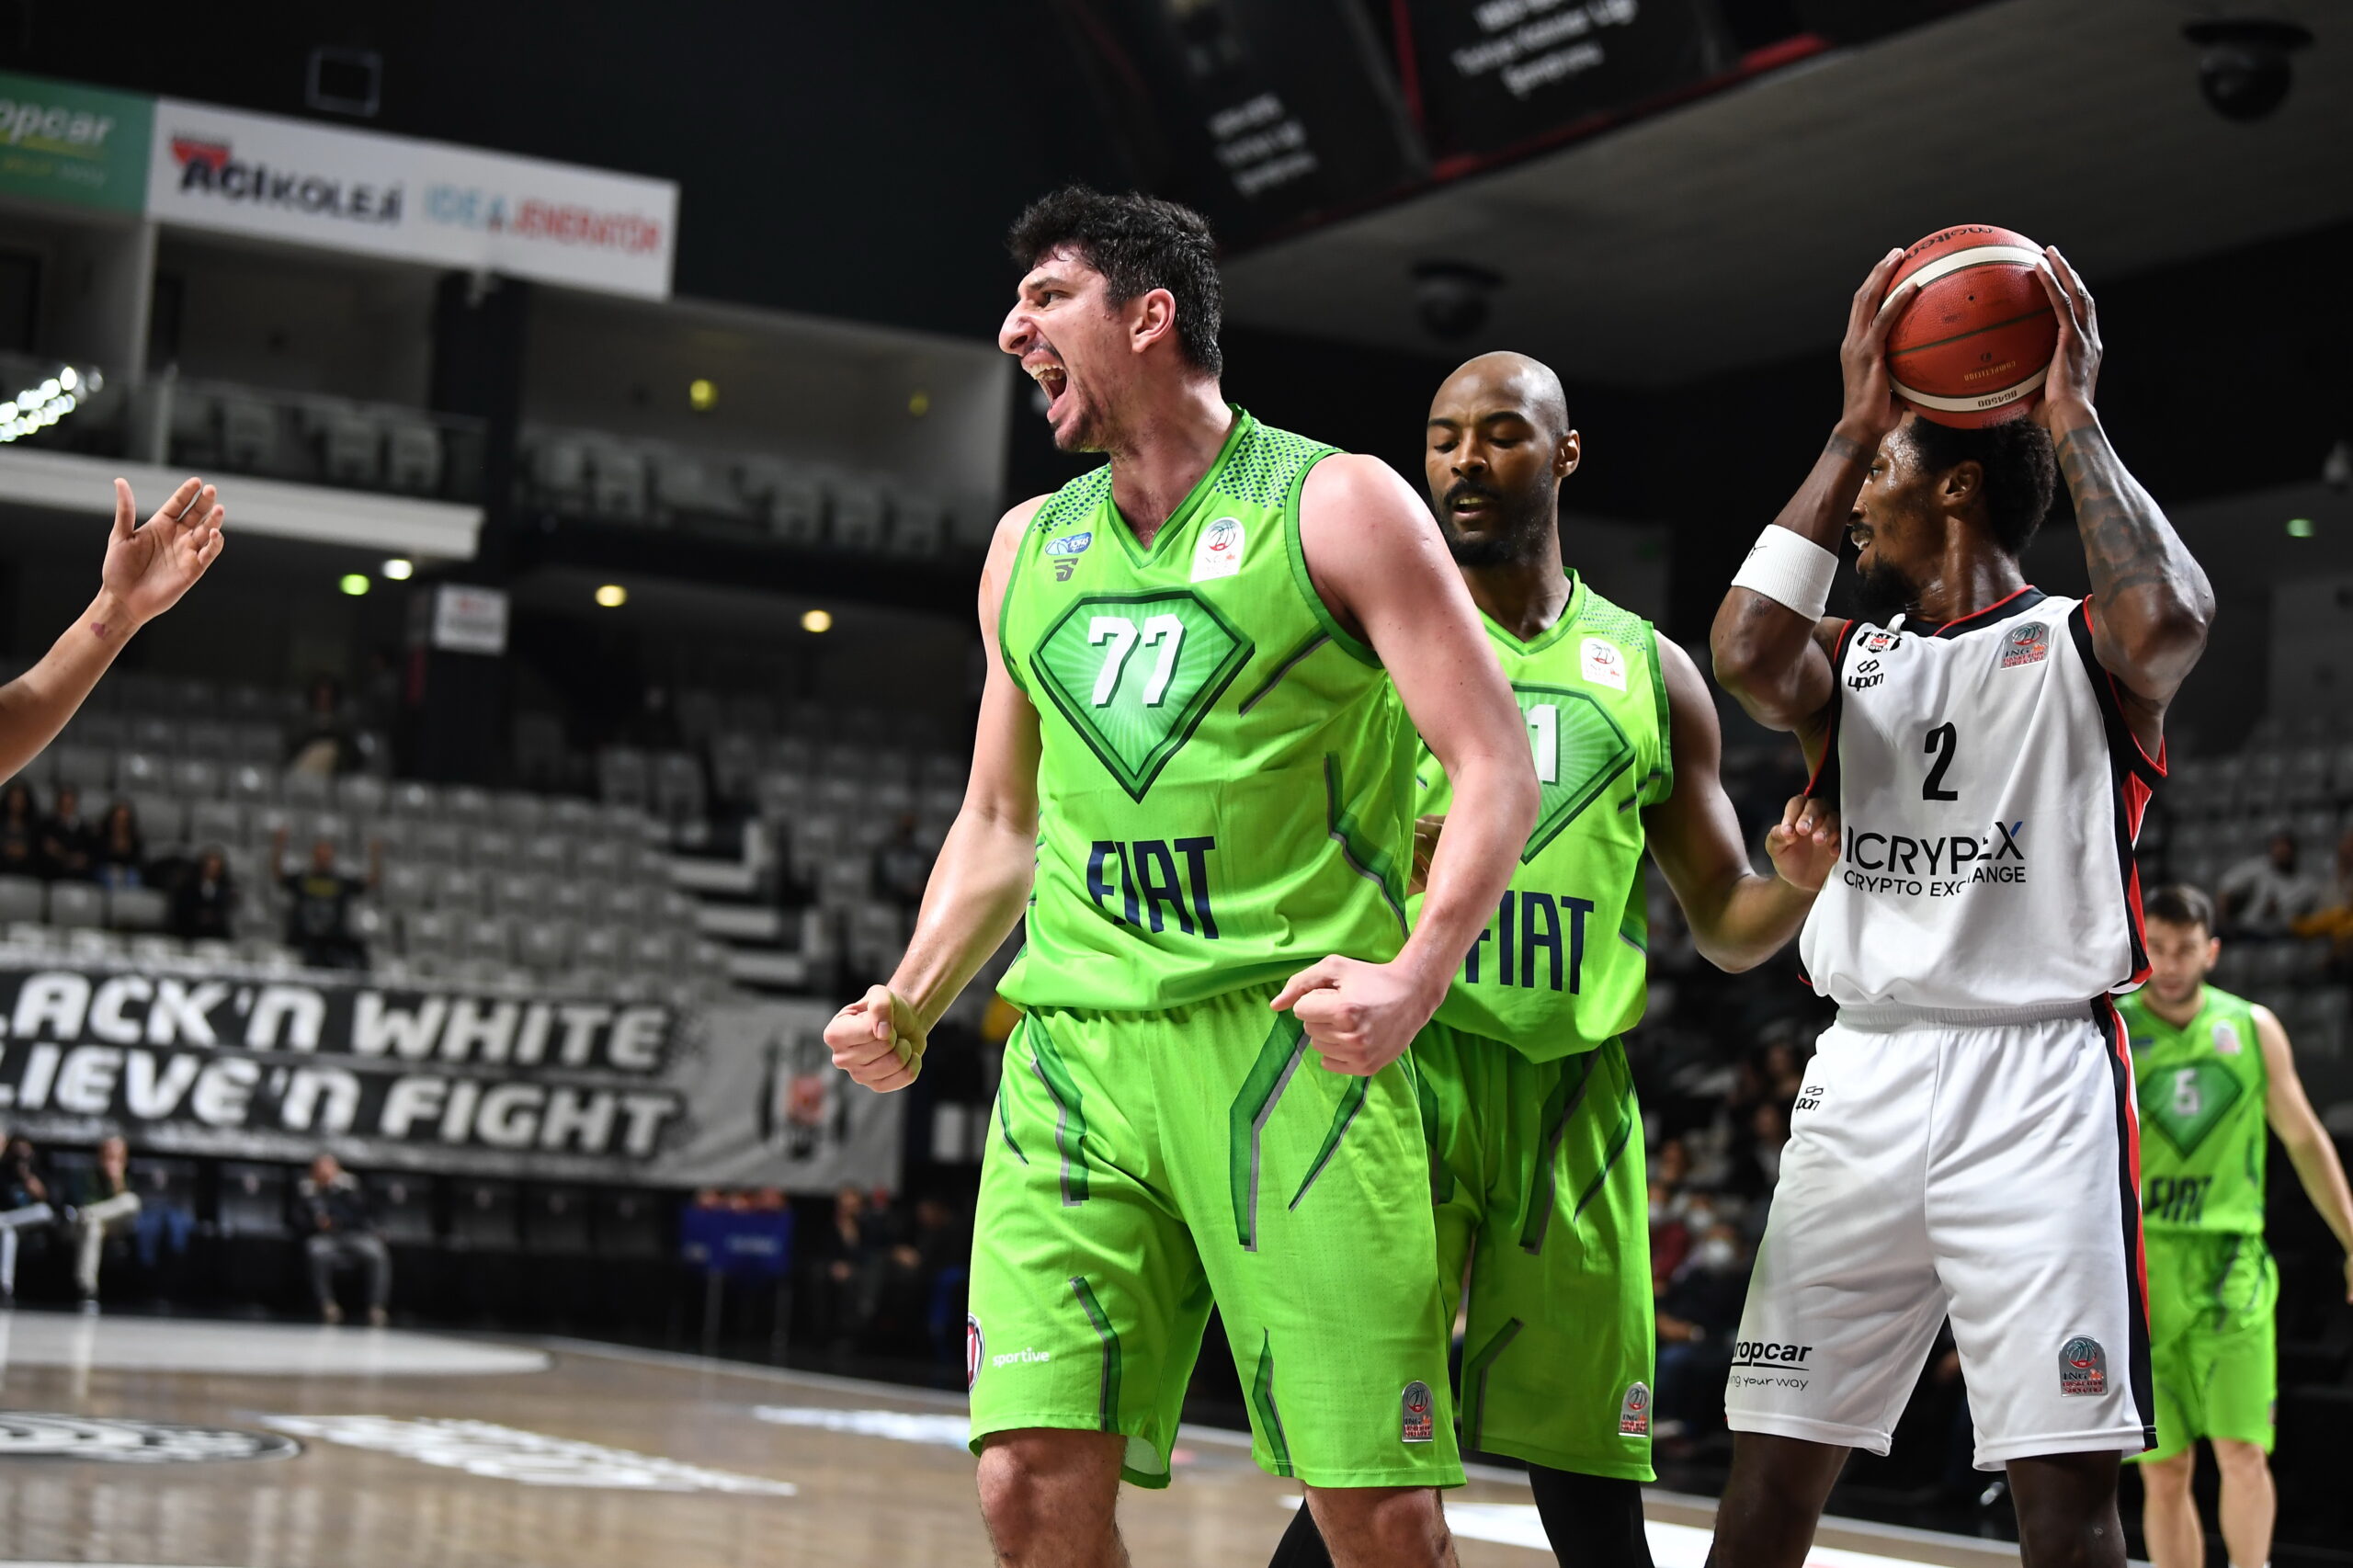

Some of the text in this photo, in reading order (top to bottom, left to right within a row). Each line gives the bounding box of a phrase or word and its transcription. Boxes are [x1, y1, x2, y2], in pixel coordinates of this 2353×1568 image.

[1087, 613, 1188, 709] 77
[1847, 673, 1884, 692] upon
[1527, 703, 1561, 787] 1
[1922, 721, 1959, 801] 2
[1086, 835, 1219, 939] FIAT
[1843, 866, 2027, 897] CRYPTO EXCANGE
[0, 971, 669, 1070] ACK'N WHITE
[379, 1074, 676, 1157] FIGHT
[2142, 1175, 2212, 1224] FIAT
[992, 1347, 1050, 1368] sportive
[1743, 1377, 1774, 1388] your
[1776, 1377, 1809, 1392] way
